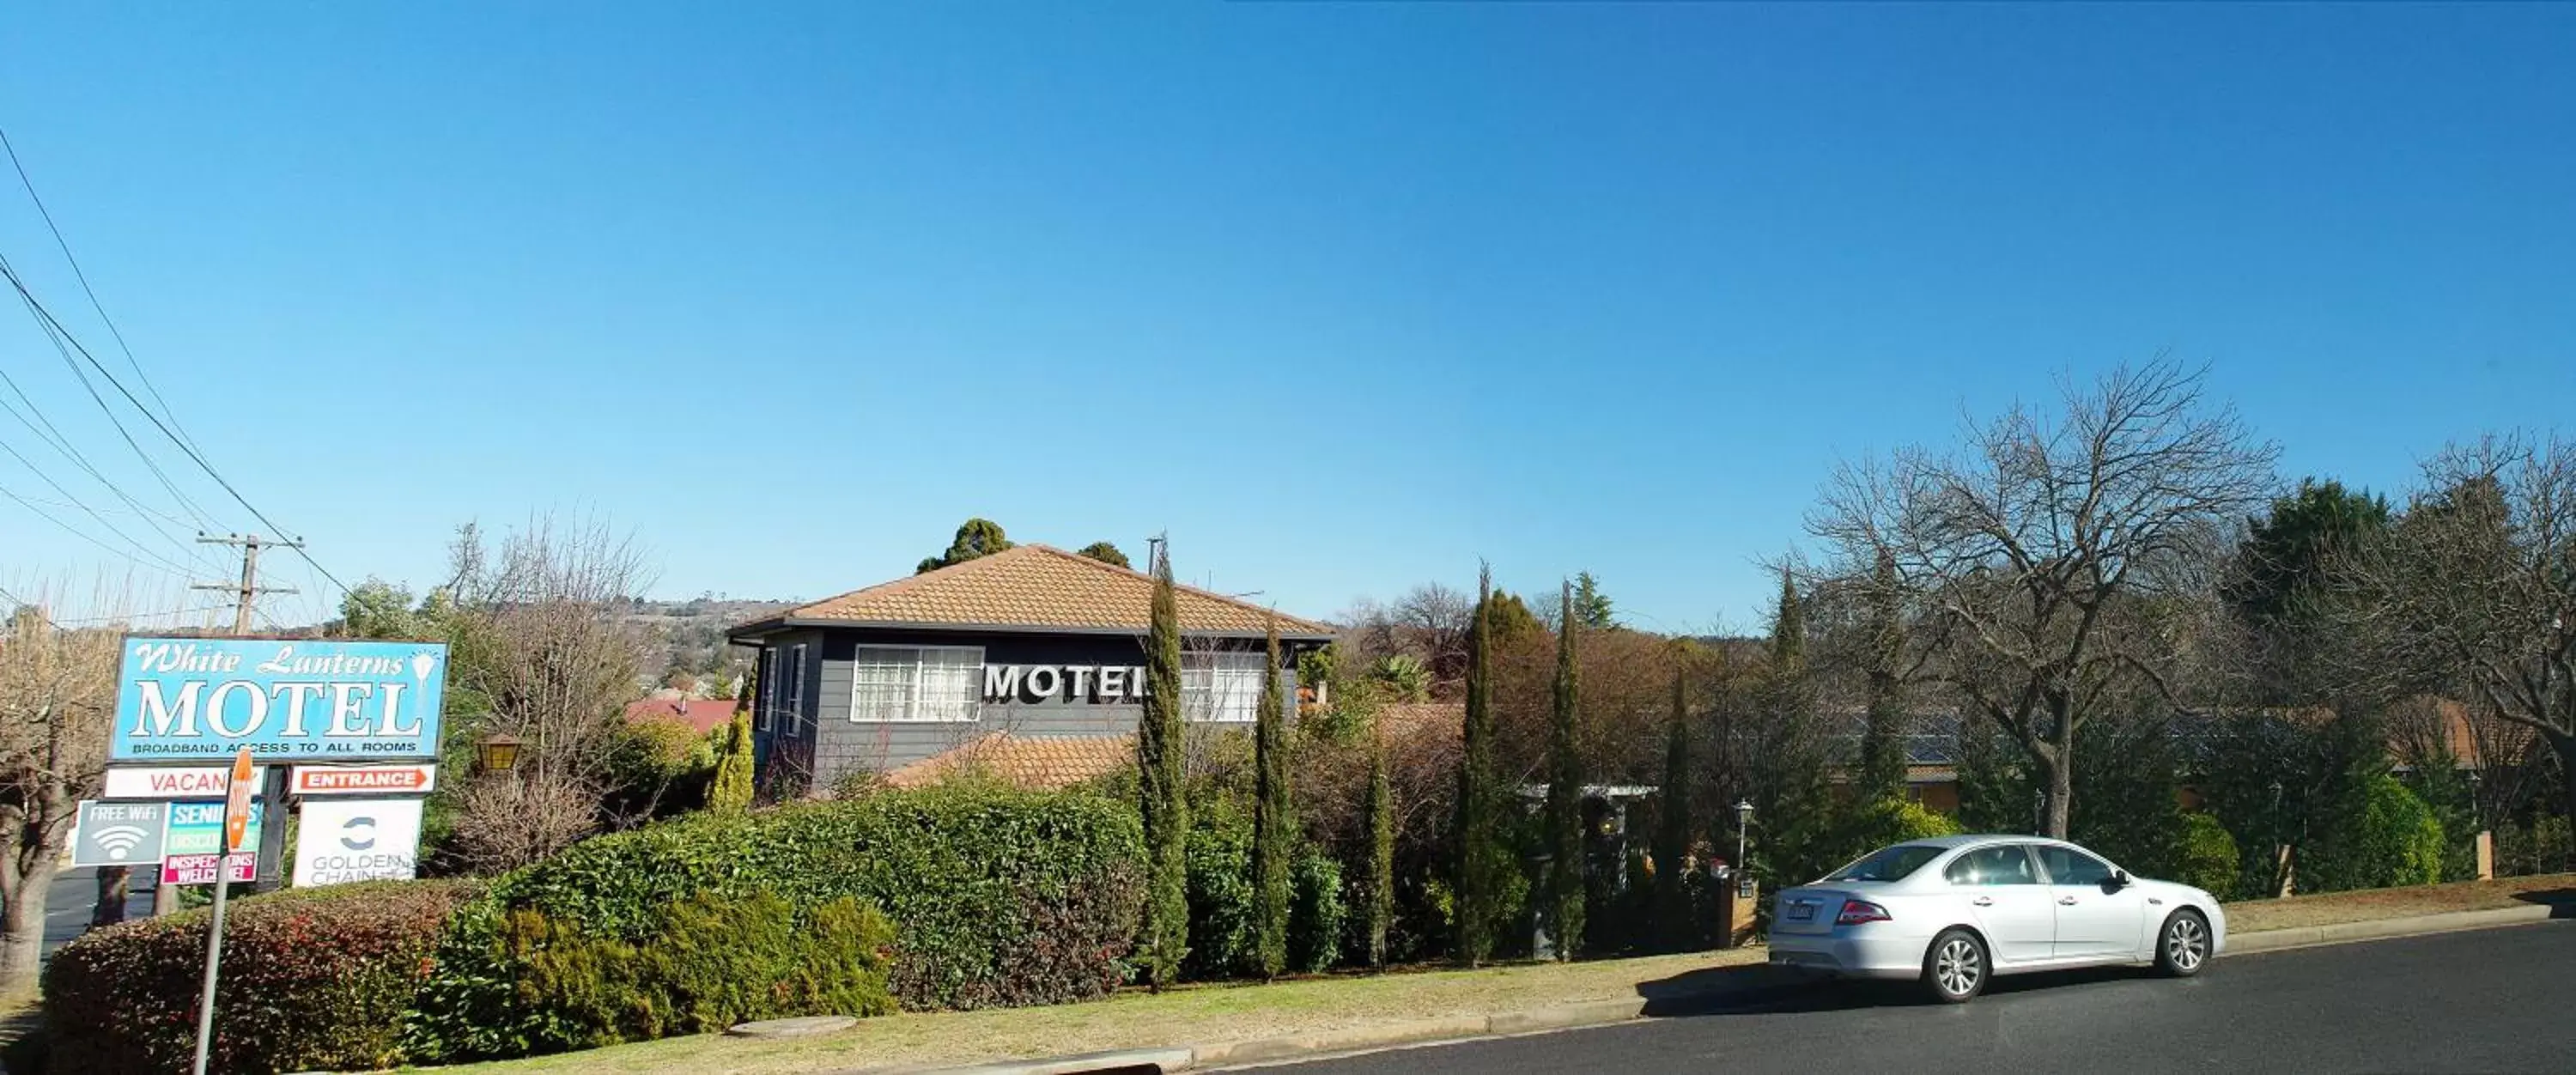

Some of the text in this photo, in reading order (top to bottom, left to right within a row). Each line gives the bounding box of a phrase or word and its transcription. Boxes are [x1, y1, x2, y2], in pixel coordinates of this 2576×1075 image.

[135, 643, 404, 674] White Lanterns
[984, 665, 1151, 697] MOTEL
[128, 679, 422, 738] MOTEL
[132, 744, 219, 754] BROADBAND
[300, 743, 319, 752] TO
[325, 743, 355, 752] ALL
[361, 743, 416, 752] ROOMS
[150, 773, 258, 791] VACAN
[307, 771, 417, 787] ENTRANCE
[89, 805, 125, 822] FREE
[173, 805, 258, 825] SENIS
[312, 854, 401, 871] GOLDEN
